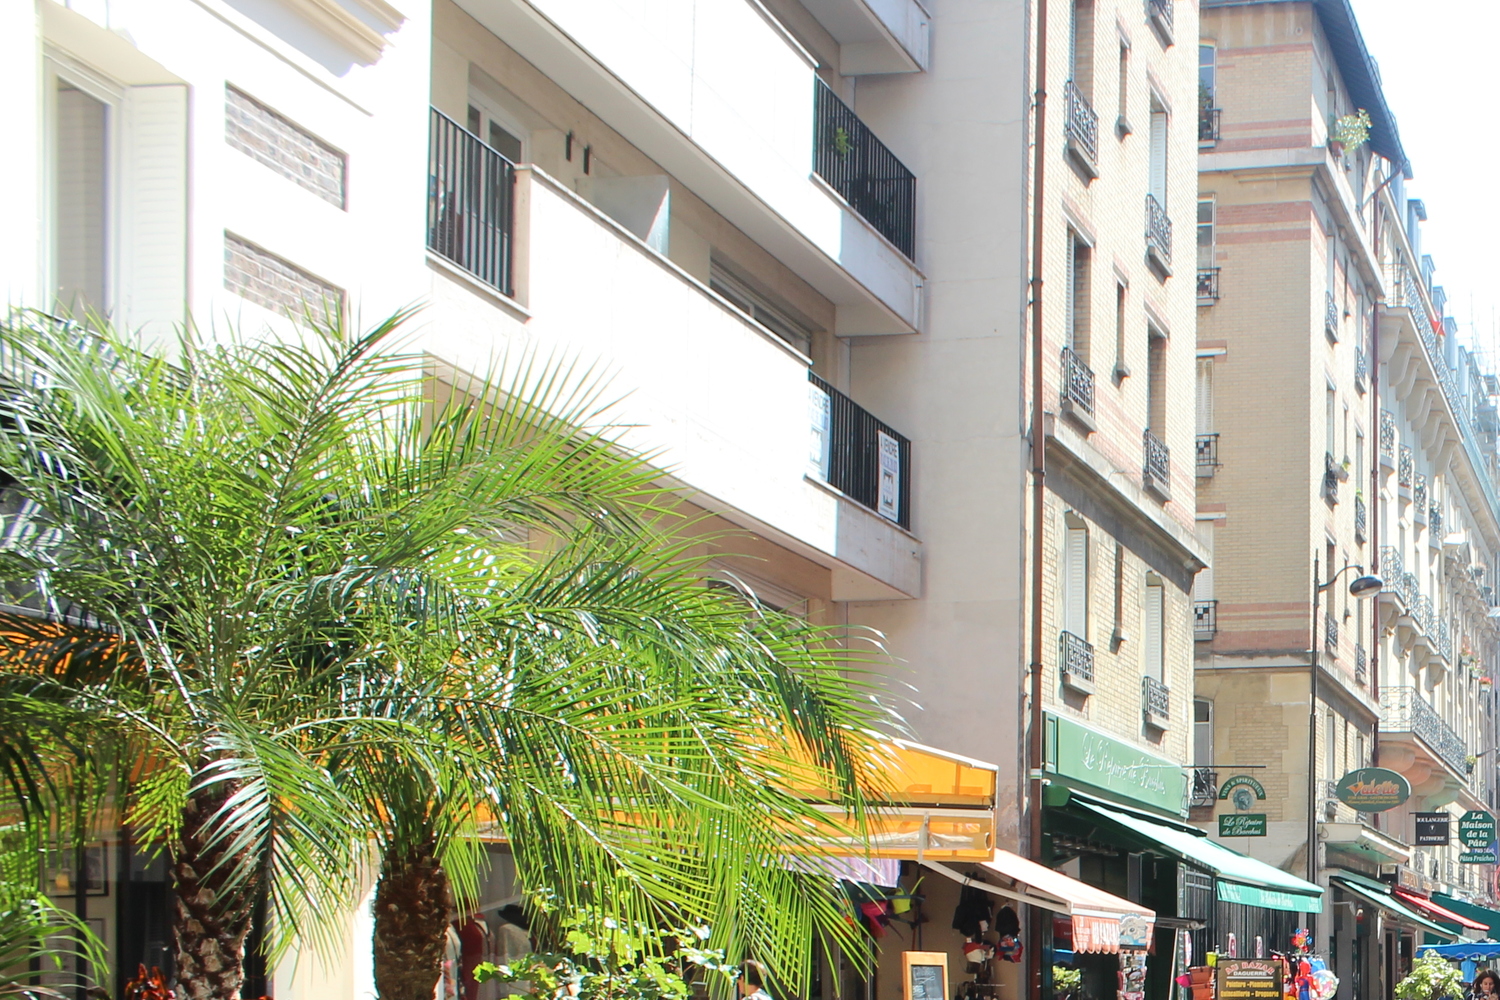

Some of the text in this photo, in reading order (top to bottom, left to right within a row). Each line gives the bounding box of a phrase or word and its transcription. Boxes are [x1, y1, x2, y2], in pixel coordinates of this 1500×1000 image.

[1346, 772, 1399, 796] Valette
[1471, 812, 1483, 820] La
[1466, 830, 1488, 838] de la
[1467, 840, 1488, 848] Pâte
[1225, 962, 1275, 975] AU BAZAR
